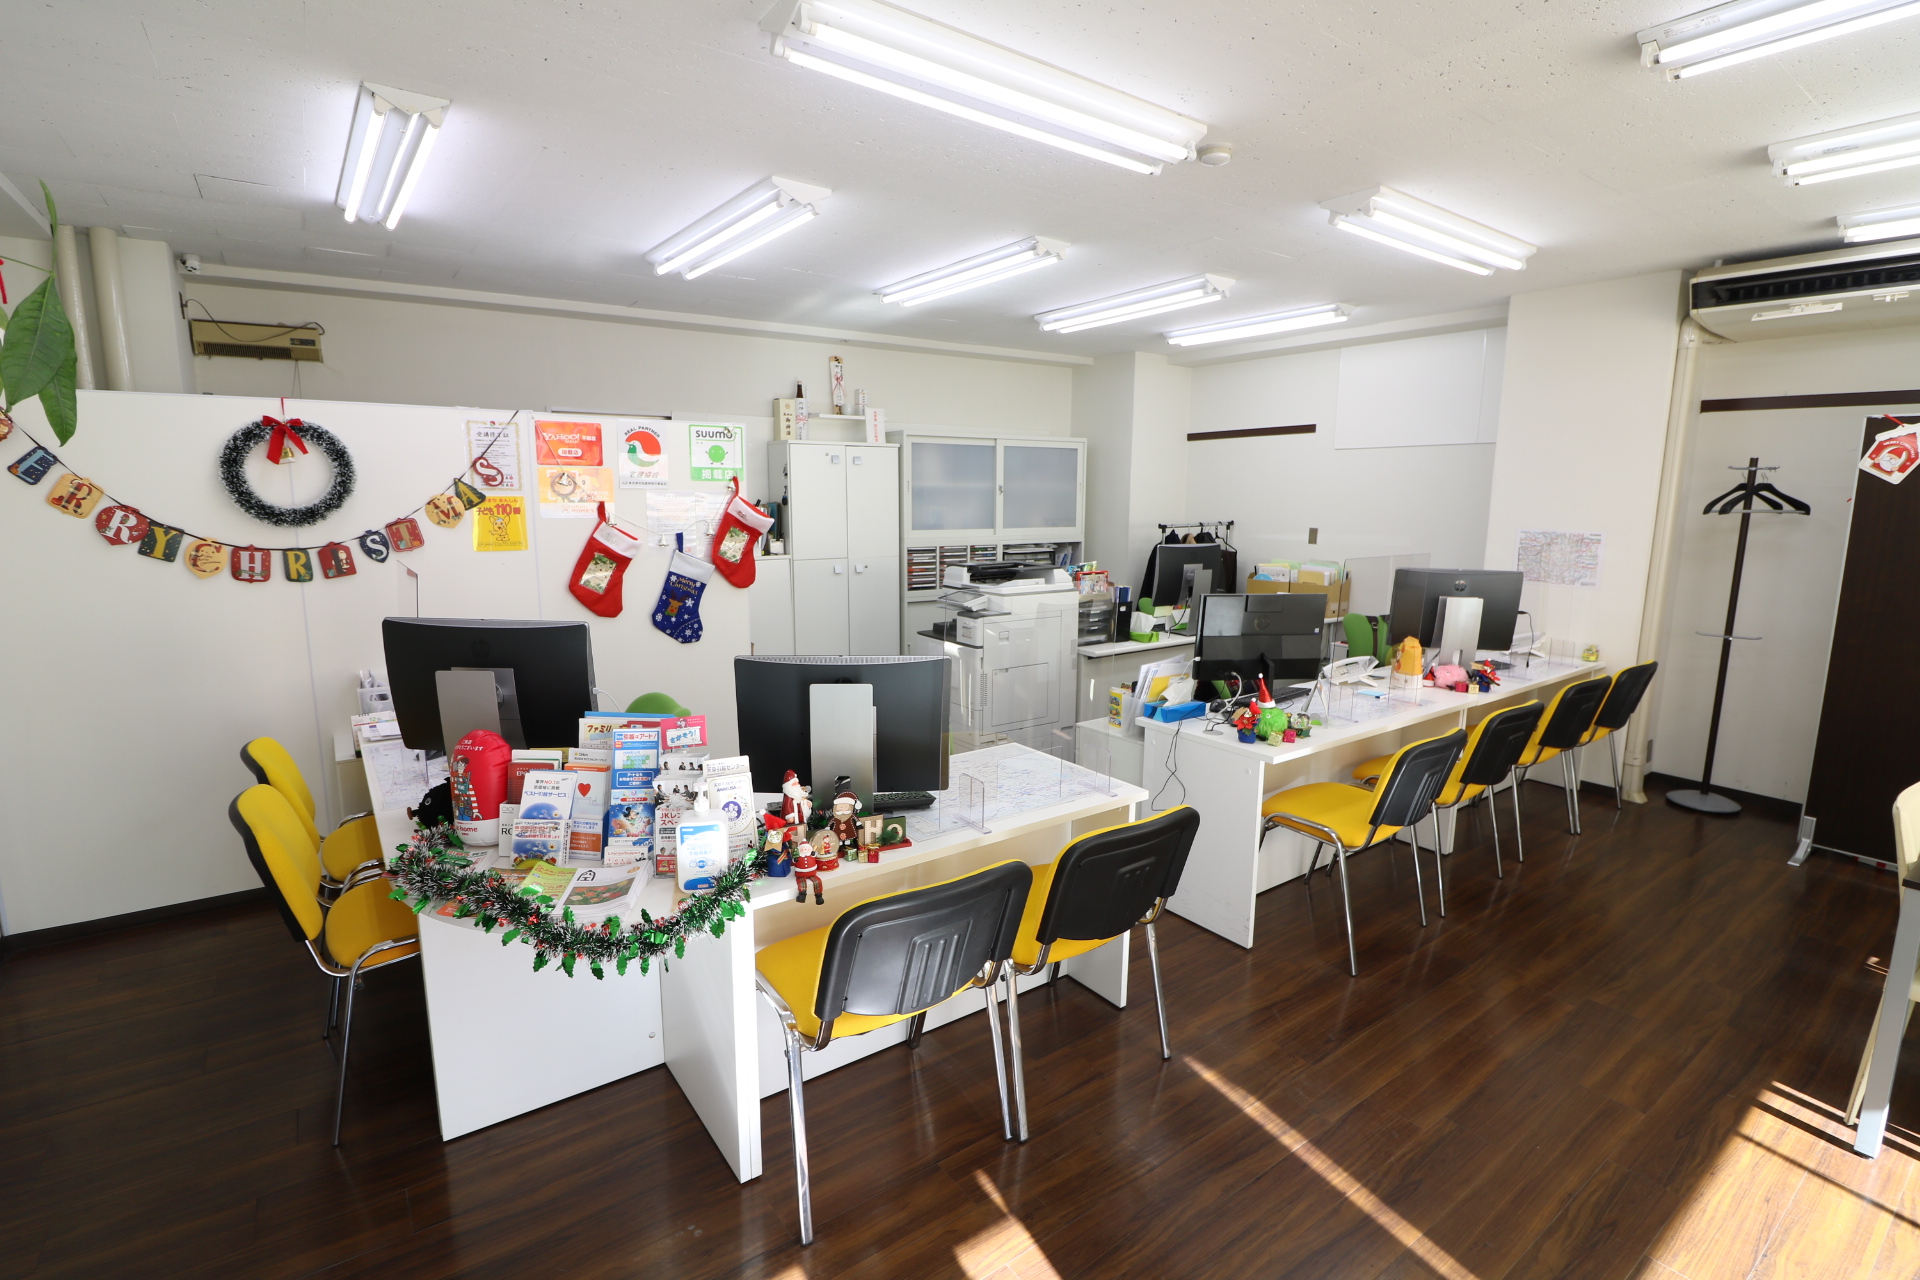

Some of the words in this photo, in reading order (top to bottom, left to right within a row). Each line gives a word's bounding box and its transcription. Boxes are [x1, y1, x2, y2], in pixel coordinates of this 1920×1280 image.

[624, 427, 637, 436] REAL
[638, 426, 661, 438] PARTNER
[701, 468, 734, 480] 掲載店
